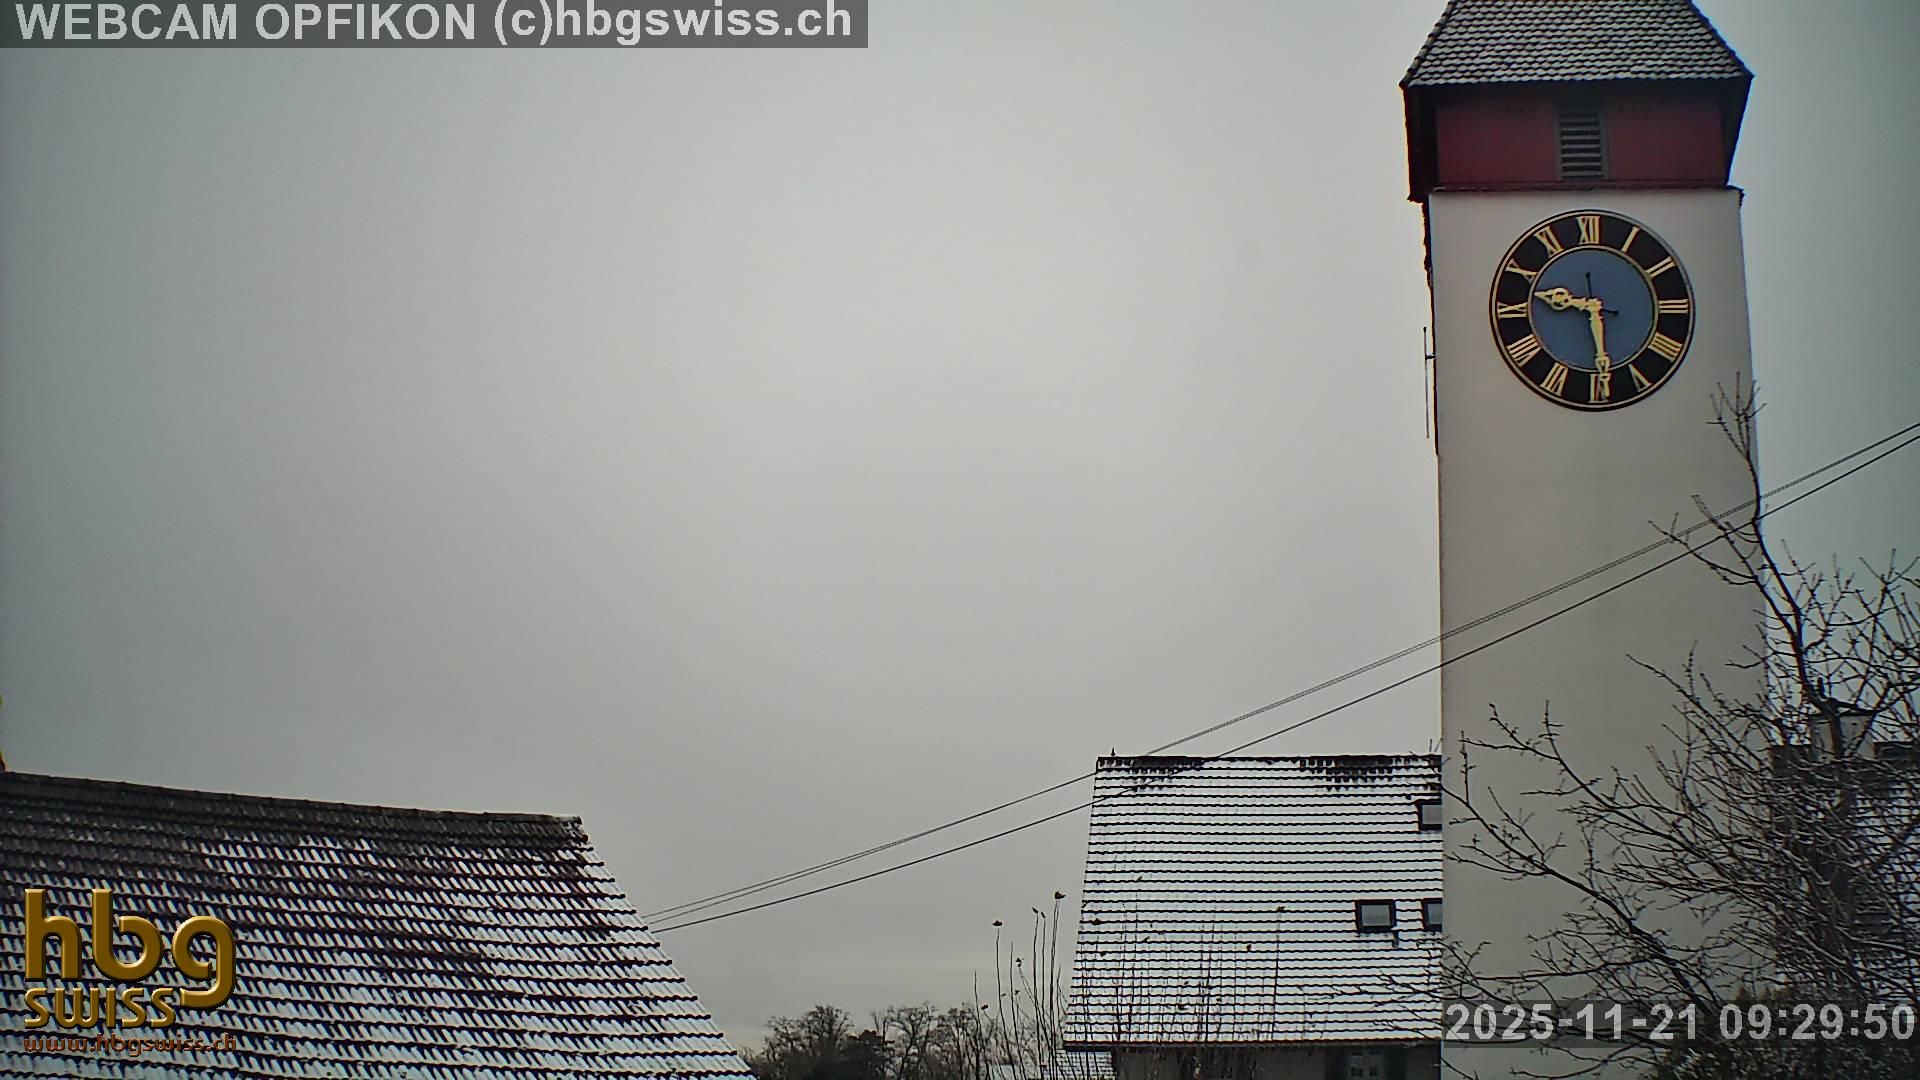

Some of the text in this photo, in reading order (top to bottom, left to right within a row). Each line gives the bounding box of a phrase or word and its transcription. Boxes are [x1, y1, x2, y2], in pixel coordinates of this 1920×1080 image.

[1534, 226, 1564, 258] XI
[1576, 215, 1600, 244] XII
[1620, 226, 1641, 252] I
[1504, 258, 1538, 283] X
[1644, 256, 1676, 278] II
[1497, 301, 1529, 319] IX
[1658, 298, 1689, 314] III
[1506, 333, 1542, 367] VIII
[1647, 332, 1683, 362] IIII
[1540, 362, 1569, 397] VII
[1628, 363, 1653, 392] V
